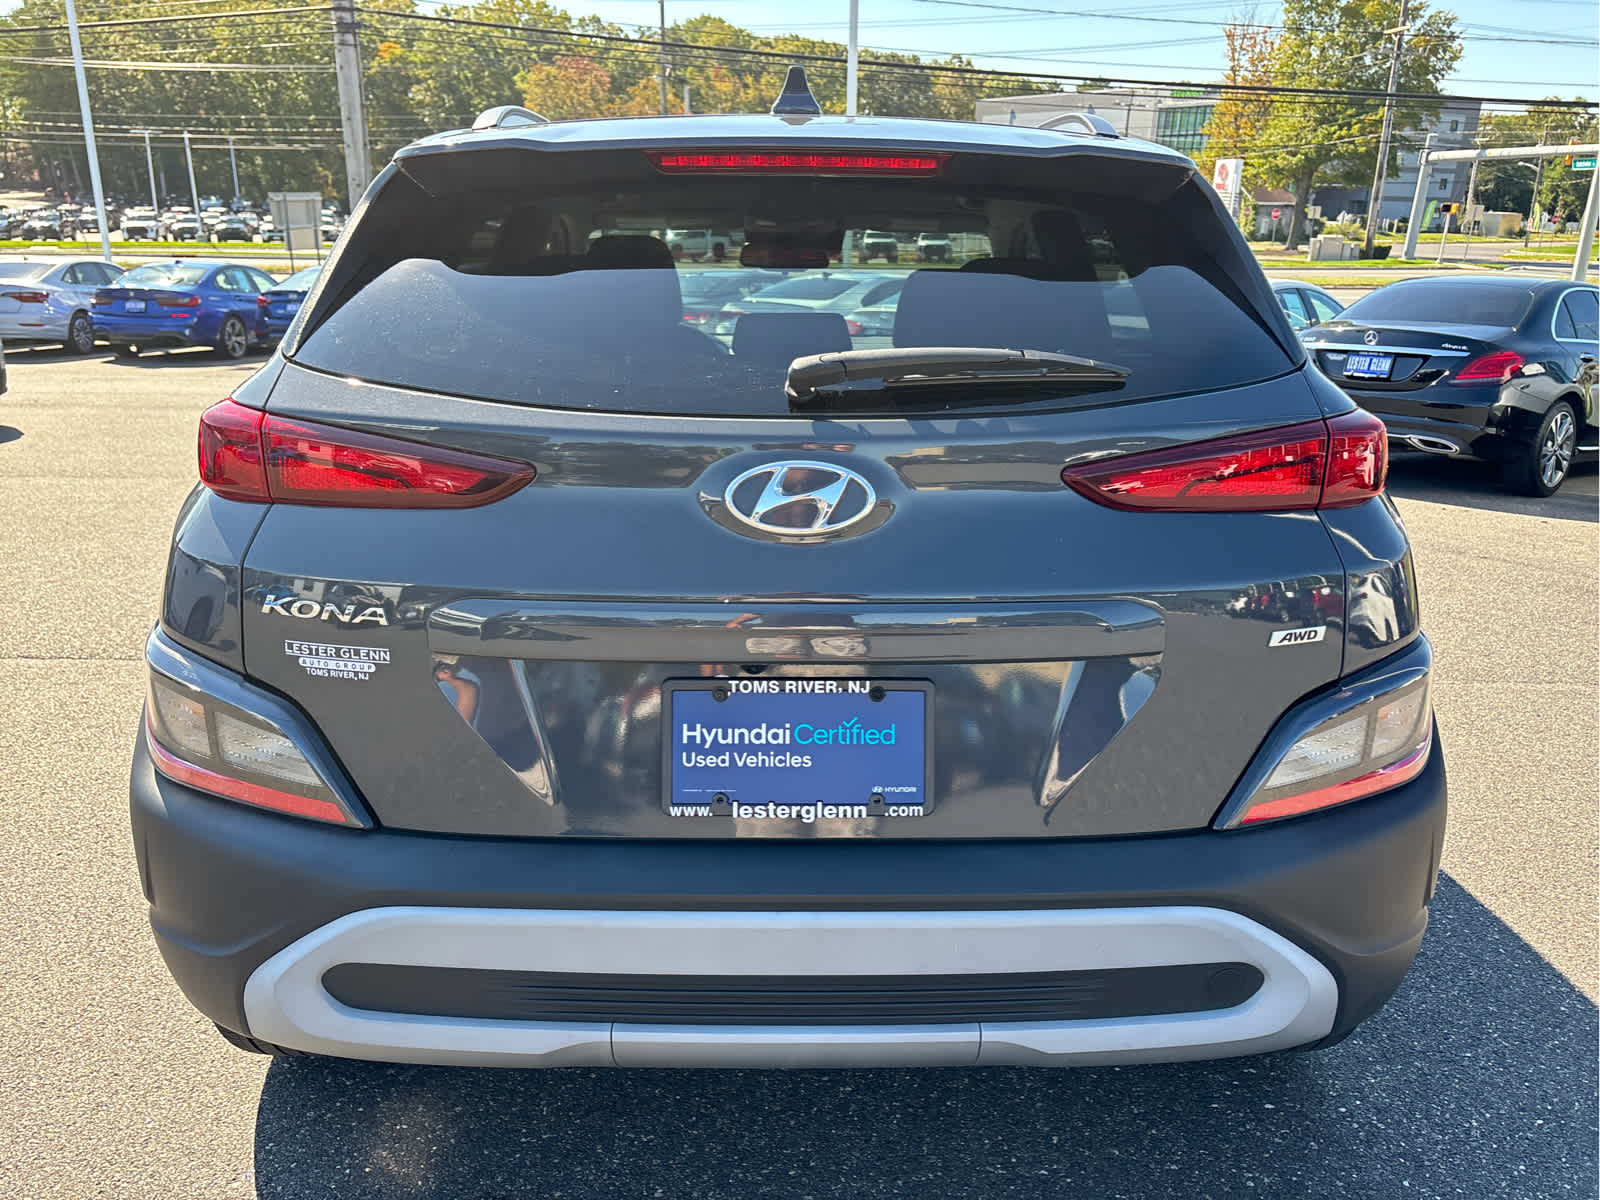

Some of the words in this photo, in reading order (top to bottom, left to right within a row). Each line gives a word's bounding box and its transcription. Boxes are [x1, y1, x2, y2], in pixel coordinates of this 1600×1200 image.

[261, 594, 389, 626] KONA
[1278, 630, 1318, 643] AWD
[284, 642, 336, 657] LESTER
[340, 649, 390, 661] GLENN
[302, 659, 329, 667] AUTO
[335, 662, 373, 671] GROUP
[306, 668, 329, 677] TOMS
[330, 670, 358, 681] RIVER,
[358, 672, 369, 680] NJ
[728, 680, 780, 694] TOMS
[785, 680, 843, 694] RIVER,
[848, 680, 870, 694] NJ
[682, 723, 791, 749] Hyundai
[794, 716, 896, 745] Certified
[682, 751, 730, 767] Used
[733, 751, 813, 768] Vehicles
[669, 805, 713, 817] www.
[732, 801, 867, 823] lesterglenn
[884, 805, 924, 817] .com
